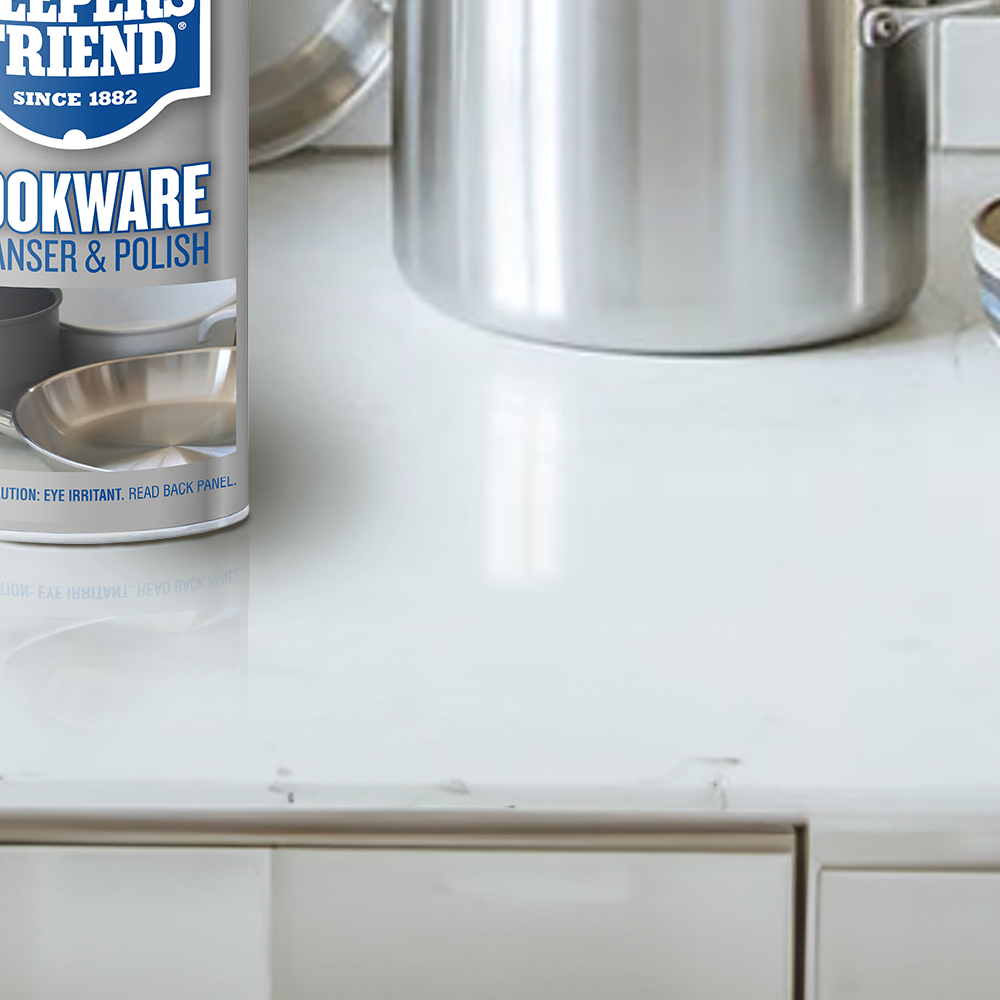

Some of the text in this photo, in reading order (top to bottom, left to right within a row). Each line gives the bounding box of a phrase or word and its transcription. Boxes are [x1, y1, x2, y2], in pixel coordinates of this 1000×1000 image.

[13, 89, 138, 107] SINCE 1882
[84, 239, 107, 274] &
[114, 231, 209, 272] POLISH
[44, 489, 65, 502] EYE
[68, 488, 124, 502] IRRITANT.
[128, 485, 160, 500] READ
[163, 481, 194, 497] BACK
[197, 476, 237, 493] PANEL.
